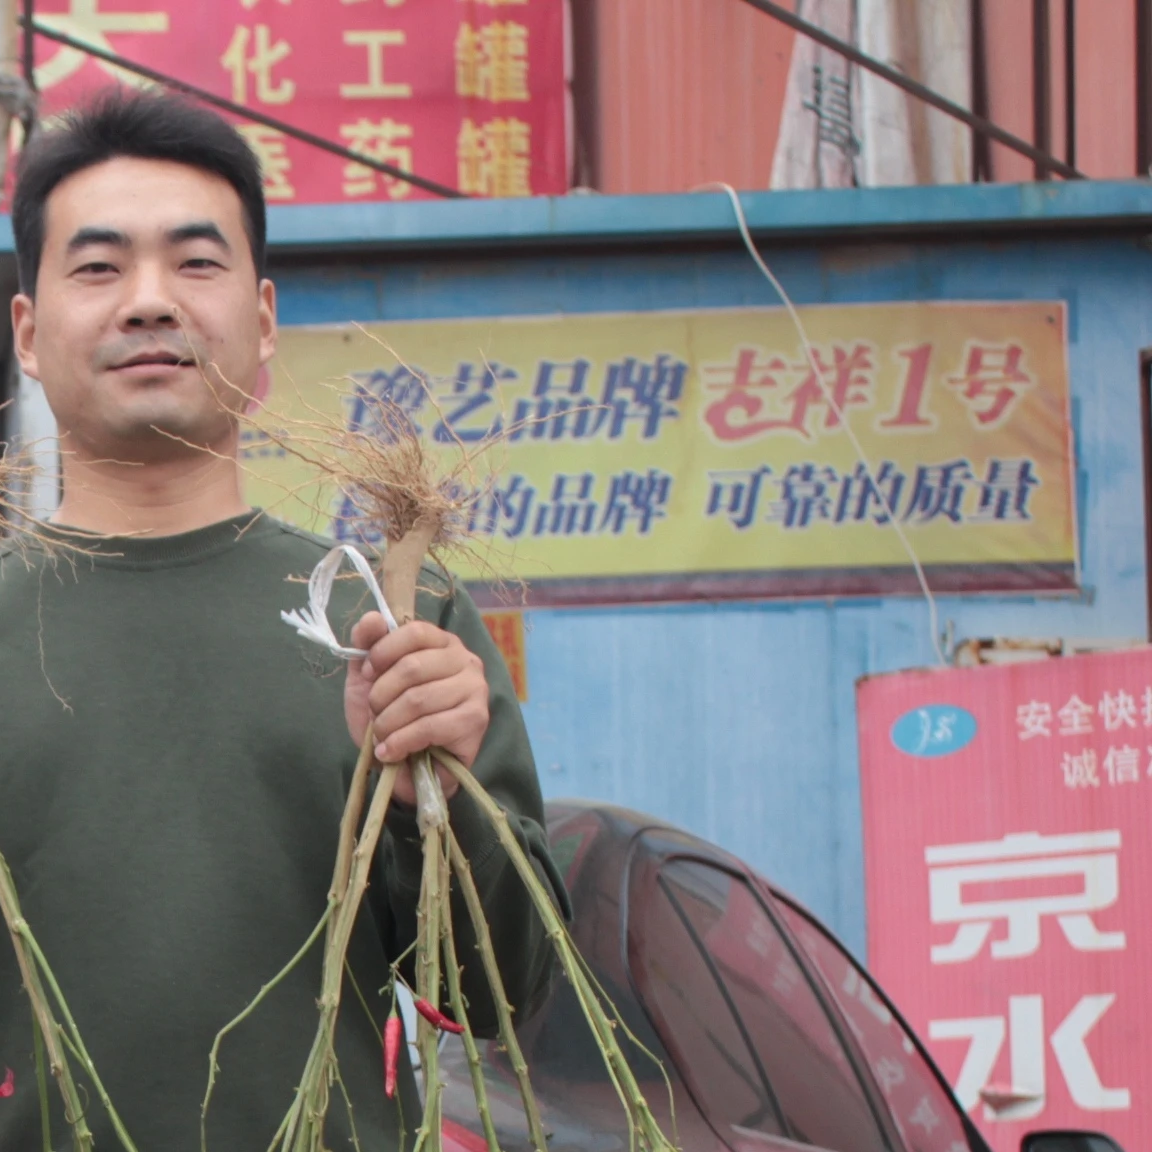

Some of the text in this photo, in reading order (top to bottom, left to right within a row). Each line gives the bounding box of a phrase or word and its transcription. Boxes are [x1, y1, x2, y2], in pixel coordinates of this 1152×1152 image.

[220, 20, 531, 104] 化工罐
[703, 342, 1032, 441] 吉祥1号
[704, 458, 1040, 529] 可靠的质量
[1060, 744, 1152, 789] 诚信
